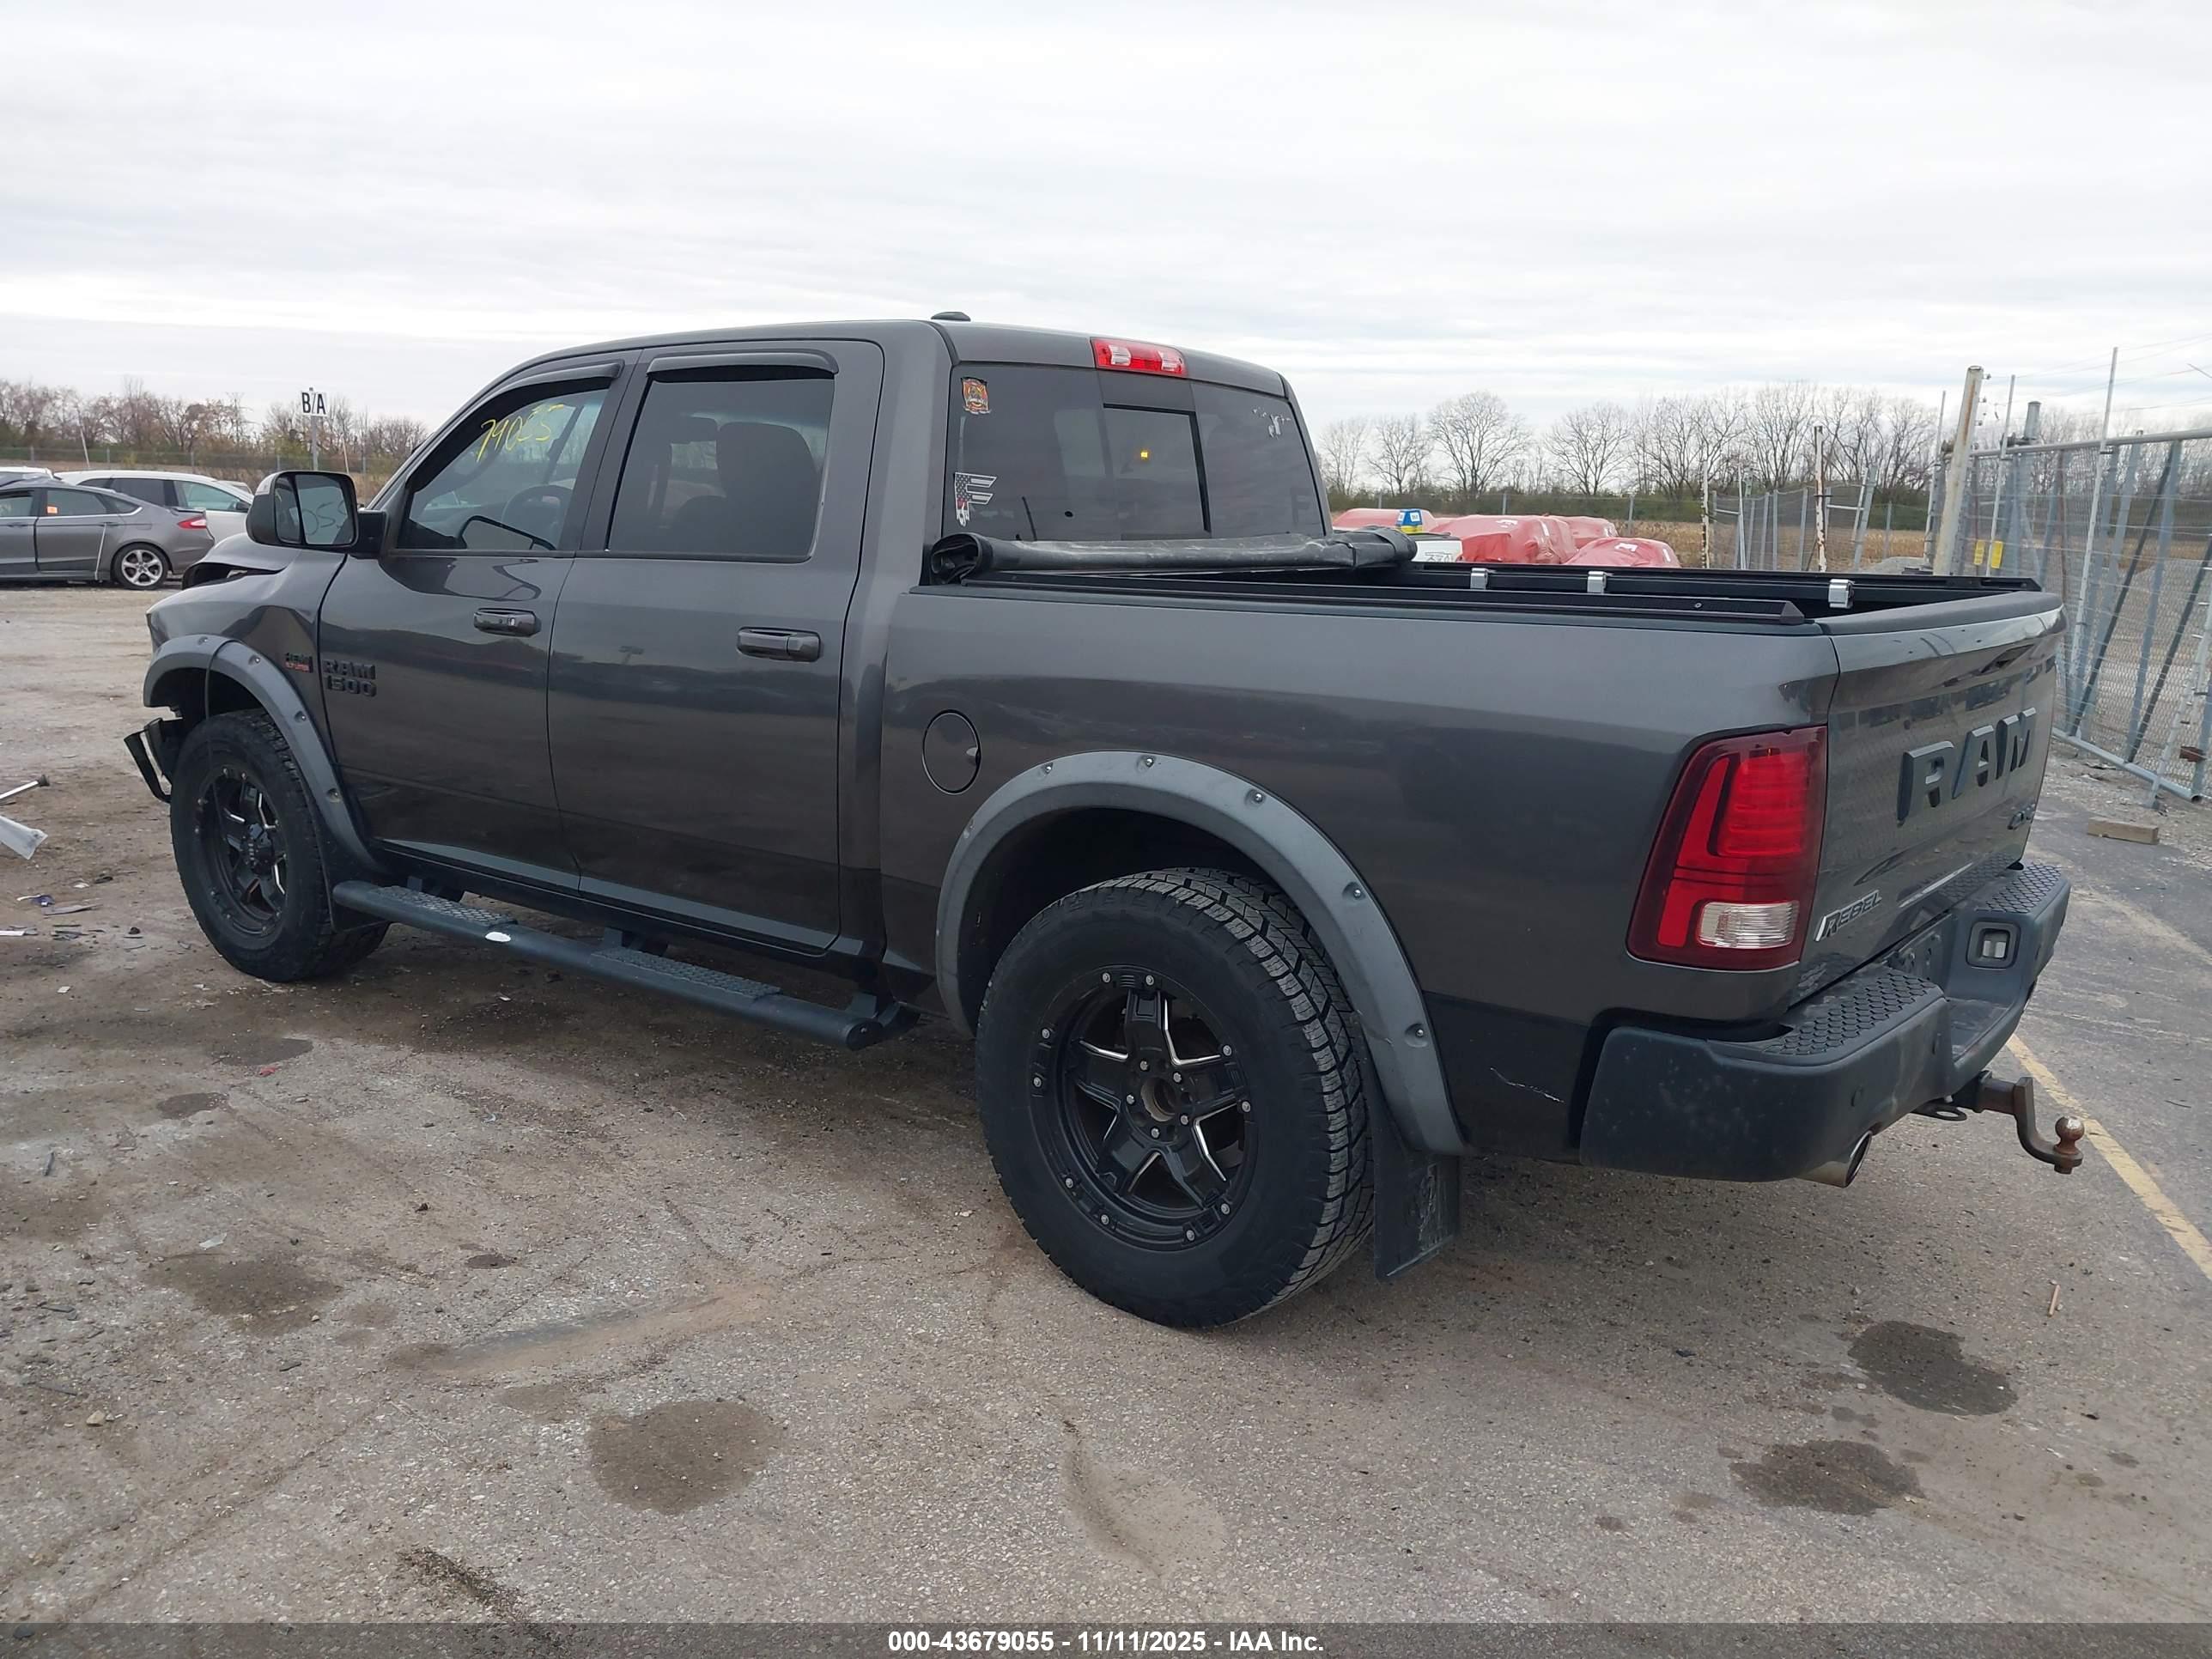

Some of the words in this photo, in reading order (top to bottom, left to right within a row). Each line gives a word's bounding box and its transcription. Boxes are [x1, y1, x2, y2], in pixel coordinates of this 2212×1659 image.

[322, 659, 375, 679] RAM
[326, 675, 377, 697] 1500
[1897, 707, 2036, 826] RAM
[1814, 890, 1882, 942] REBEL
